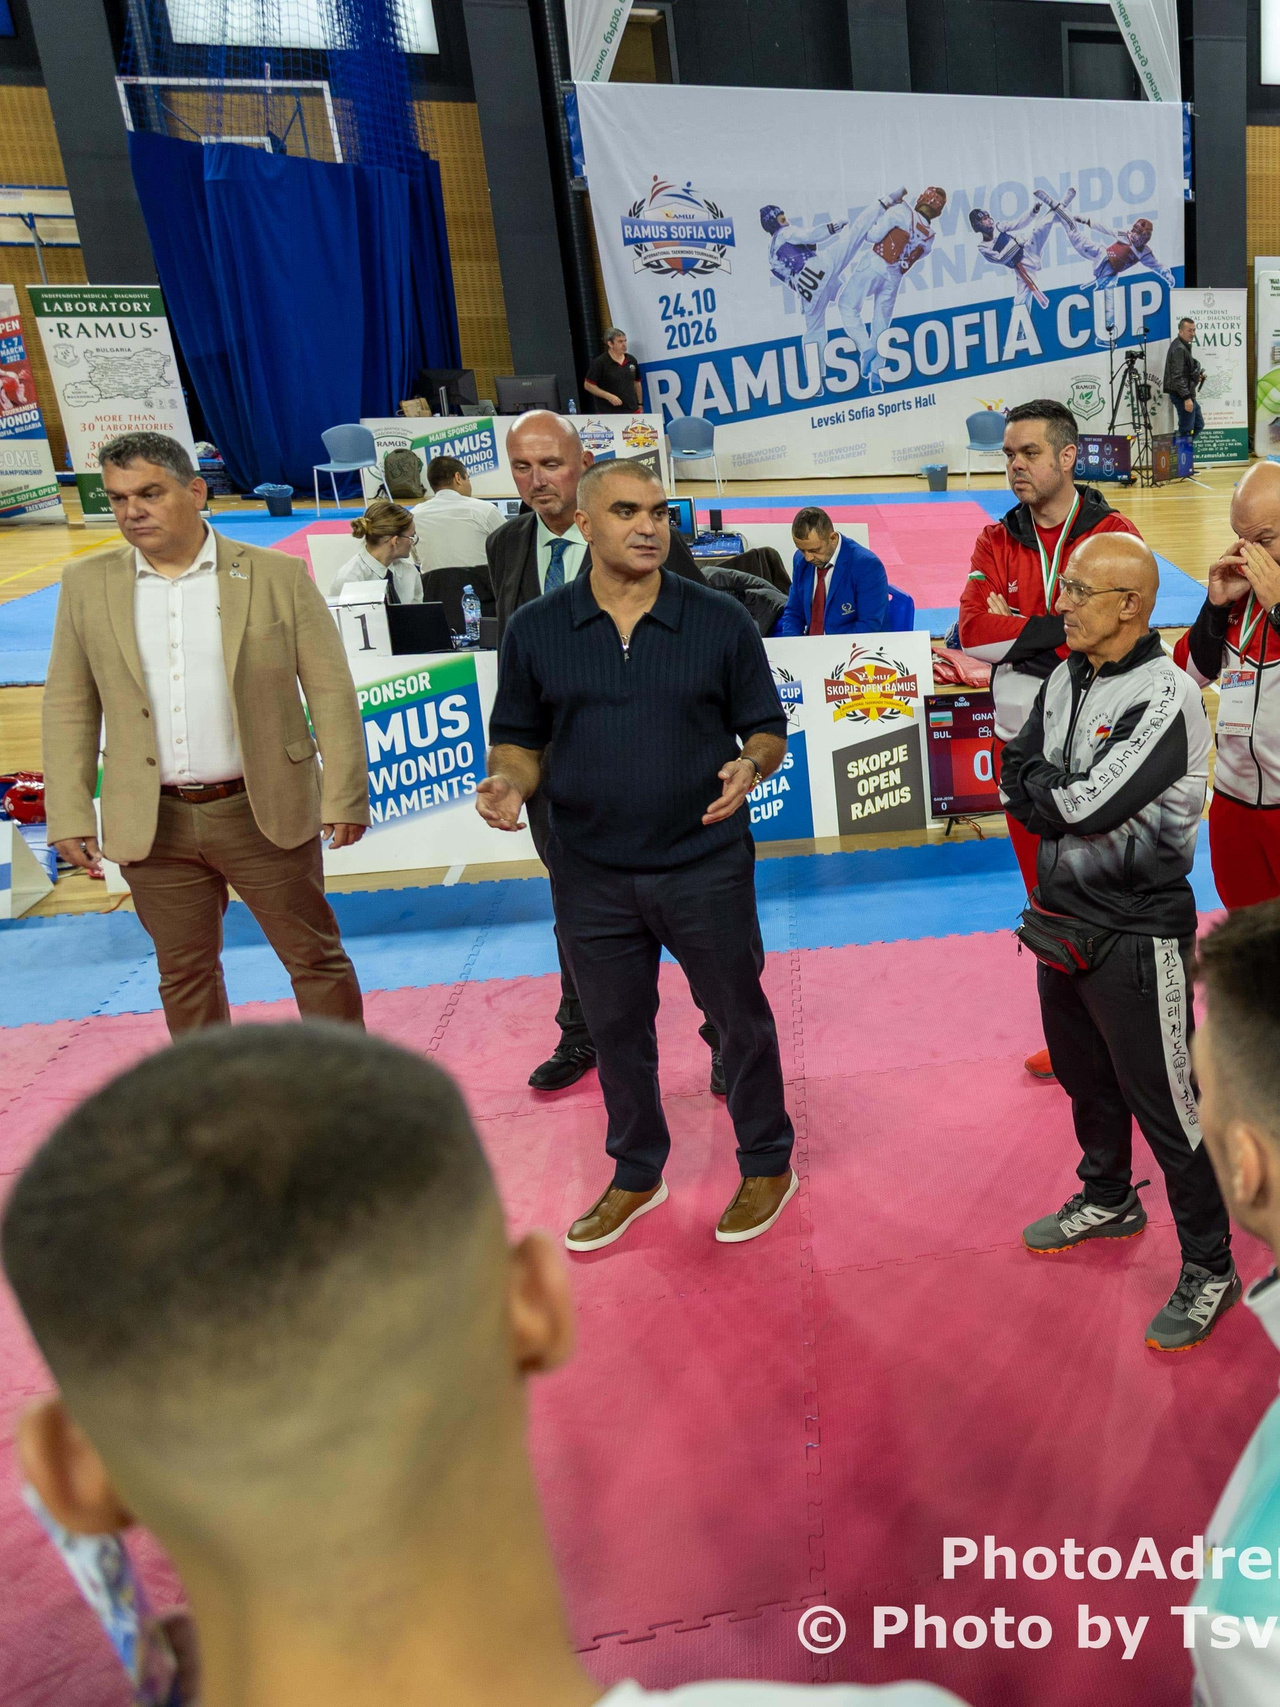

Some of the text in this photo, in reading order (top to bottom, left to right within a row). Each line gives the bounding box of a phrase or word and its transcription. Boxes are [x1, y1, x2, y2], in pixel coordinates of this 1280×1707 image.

[603, 7, 626, 45] бързо,
[624, 225, 732, 240] RAMUS SOFIA CUP
[43, 301, 151, 312] LABORATORY
[658, 287, 717, 321] 24.10
[665, 318, 717, 350] 2026
[646, 280, 1163, 424] RAMUS SOFIA CUP
[2, 402, 37, 417] TOURNAMENT
[95, 414, 123, 422] MORE
[811, 393, 937, 429] Levski Sofia Sports Hall
[80, 423, 173, 432] 30 LABORATORIES
[104, 433, 118, 441] AN
[429, 431, 446, 443] MAIN
[448, 422, 478, 437] SPONSOR
[429, 431, 492, 460] RAMUS
[17, 493, 37, 503] SOFIA
[38, 485, 57, 496] OPEN
[354, 613, 377, 651] 1
[781, 687, 801, 699] CUP
[827, 681, 916, 696] SKOPJE OPEN RAMUS
[365, 694, 471, 763] MUS
[933, 731, 952, 739] BUL
[847, 743, 909, 779] SKOPJE
[973, 749, 993, 782] 0
[857, 768, 901, 796] OPEN
[749, 799, 784, 824] CUP
[851, 786, 912, 821] RAMUS
[941, 802, 947, 810] 0
